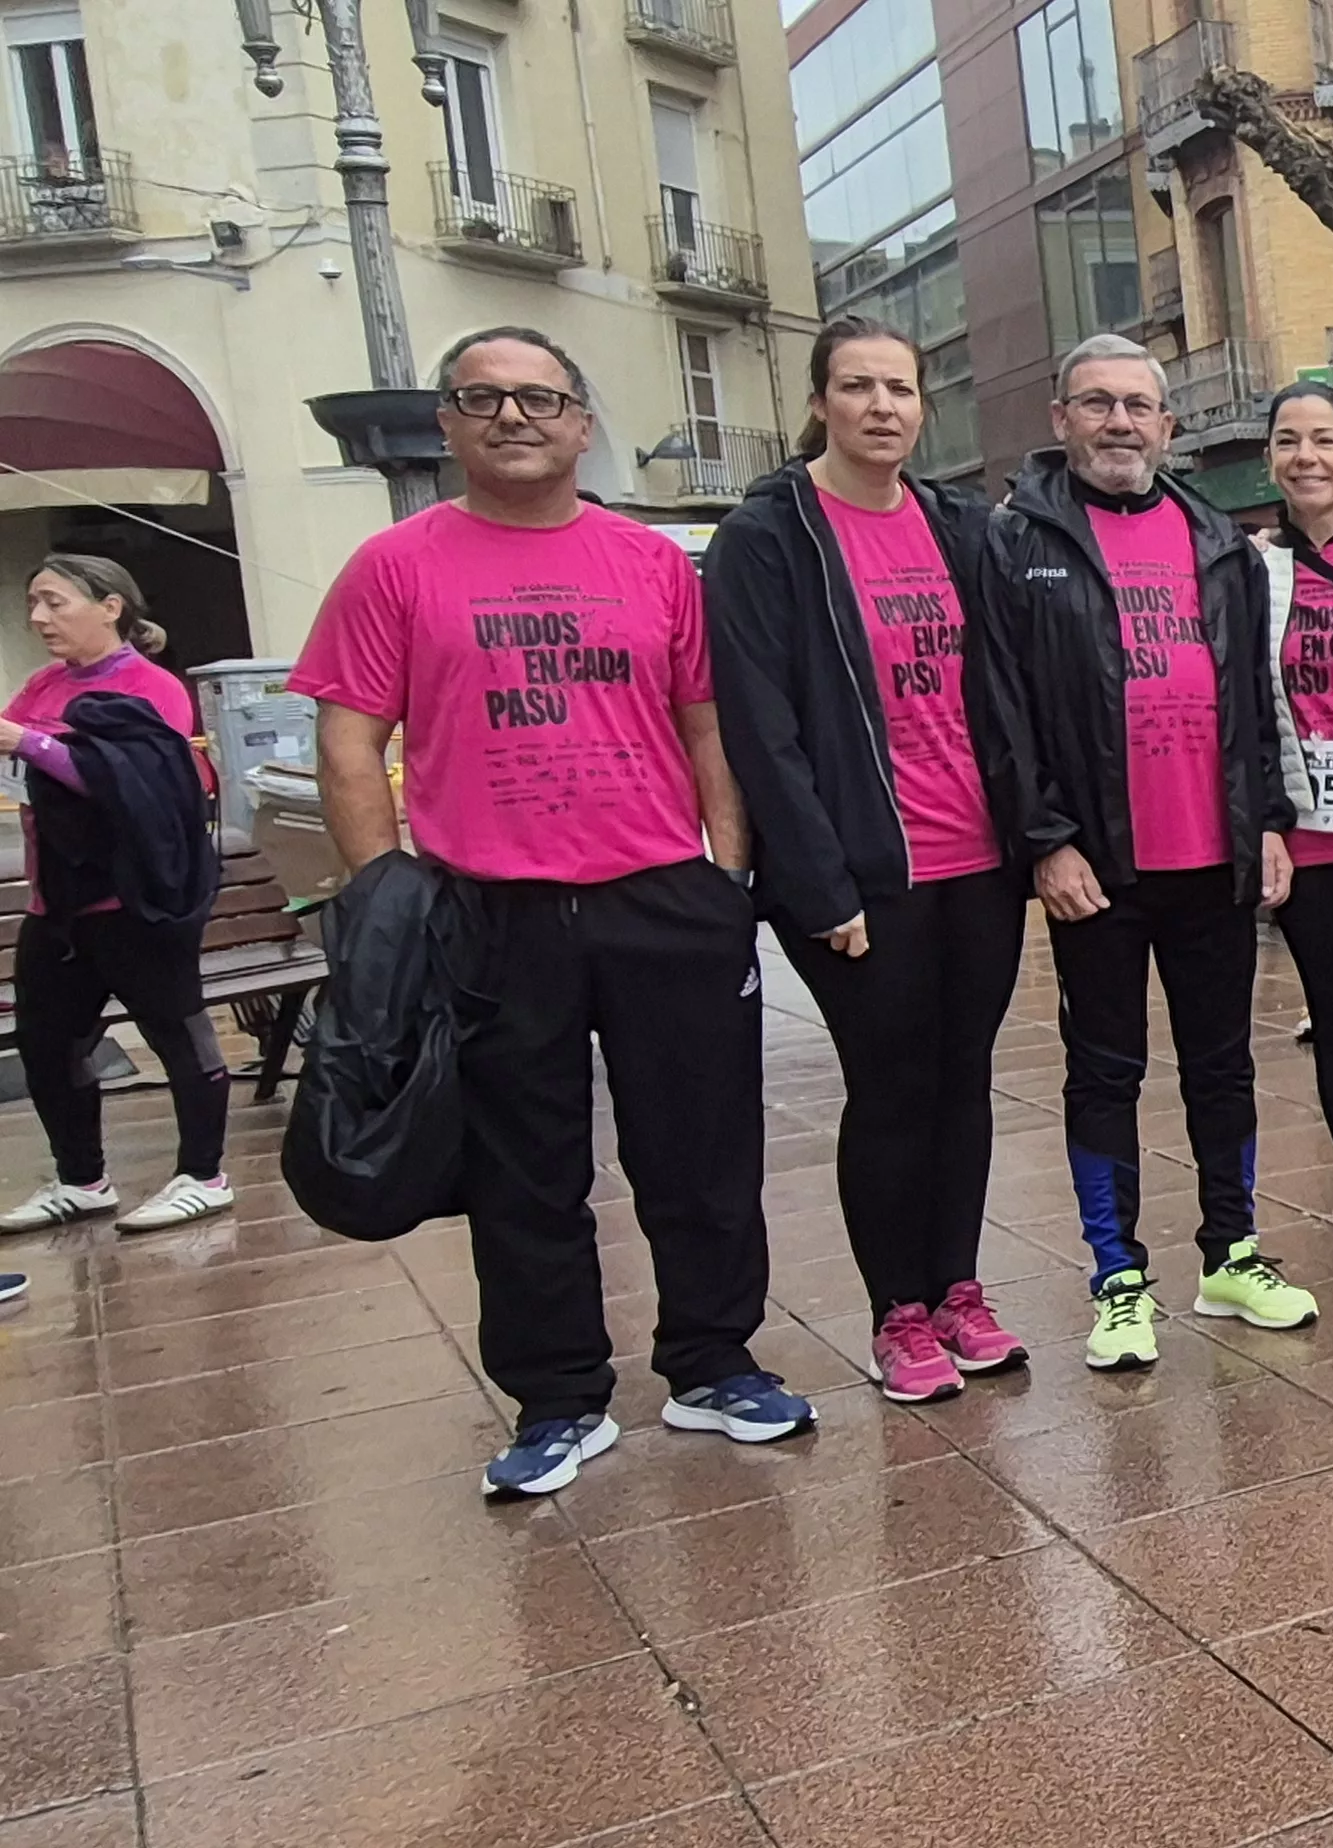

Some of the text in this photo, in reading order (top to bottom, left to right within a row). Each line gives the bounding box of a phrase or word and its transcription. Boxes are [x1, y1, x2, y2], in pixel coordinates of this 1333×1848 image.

[873, 591, 947, 627] UNIDOS
[1112, 585, 1174, 614] IDOS
[472, 610, 581, 650] UNIDOS
[1131, 616, 1206, 645] EN CAD
[1301, 634, 1327, 662] EN
[522, 646, 631, 685] EN CADA
